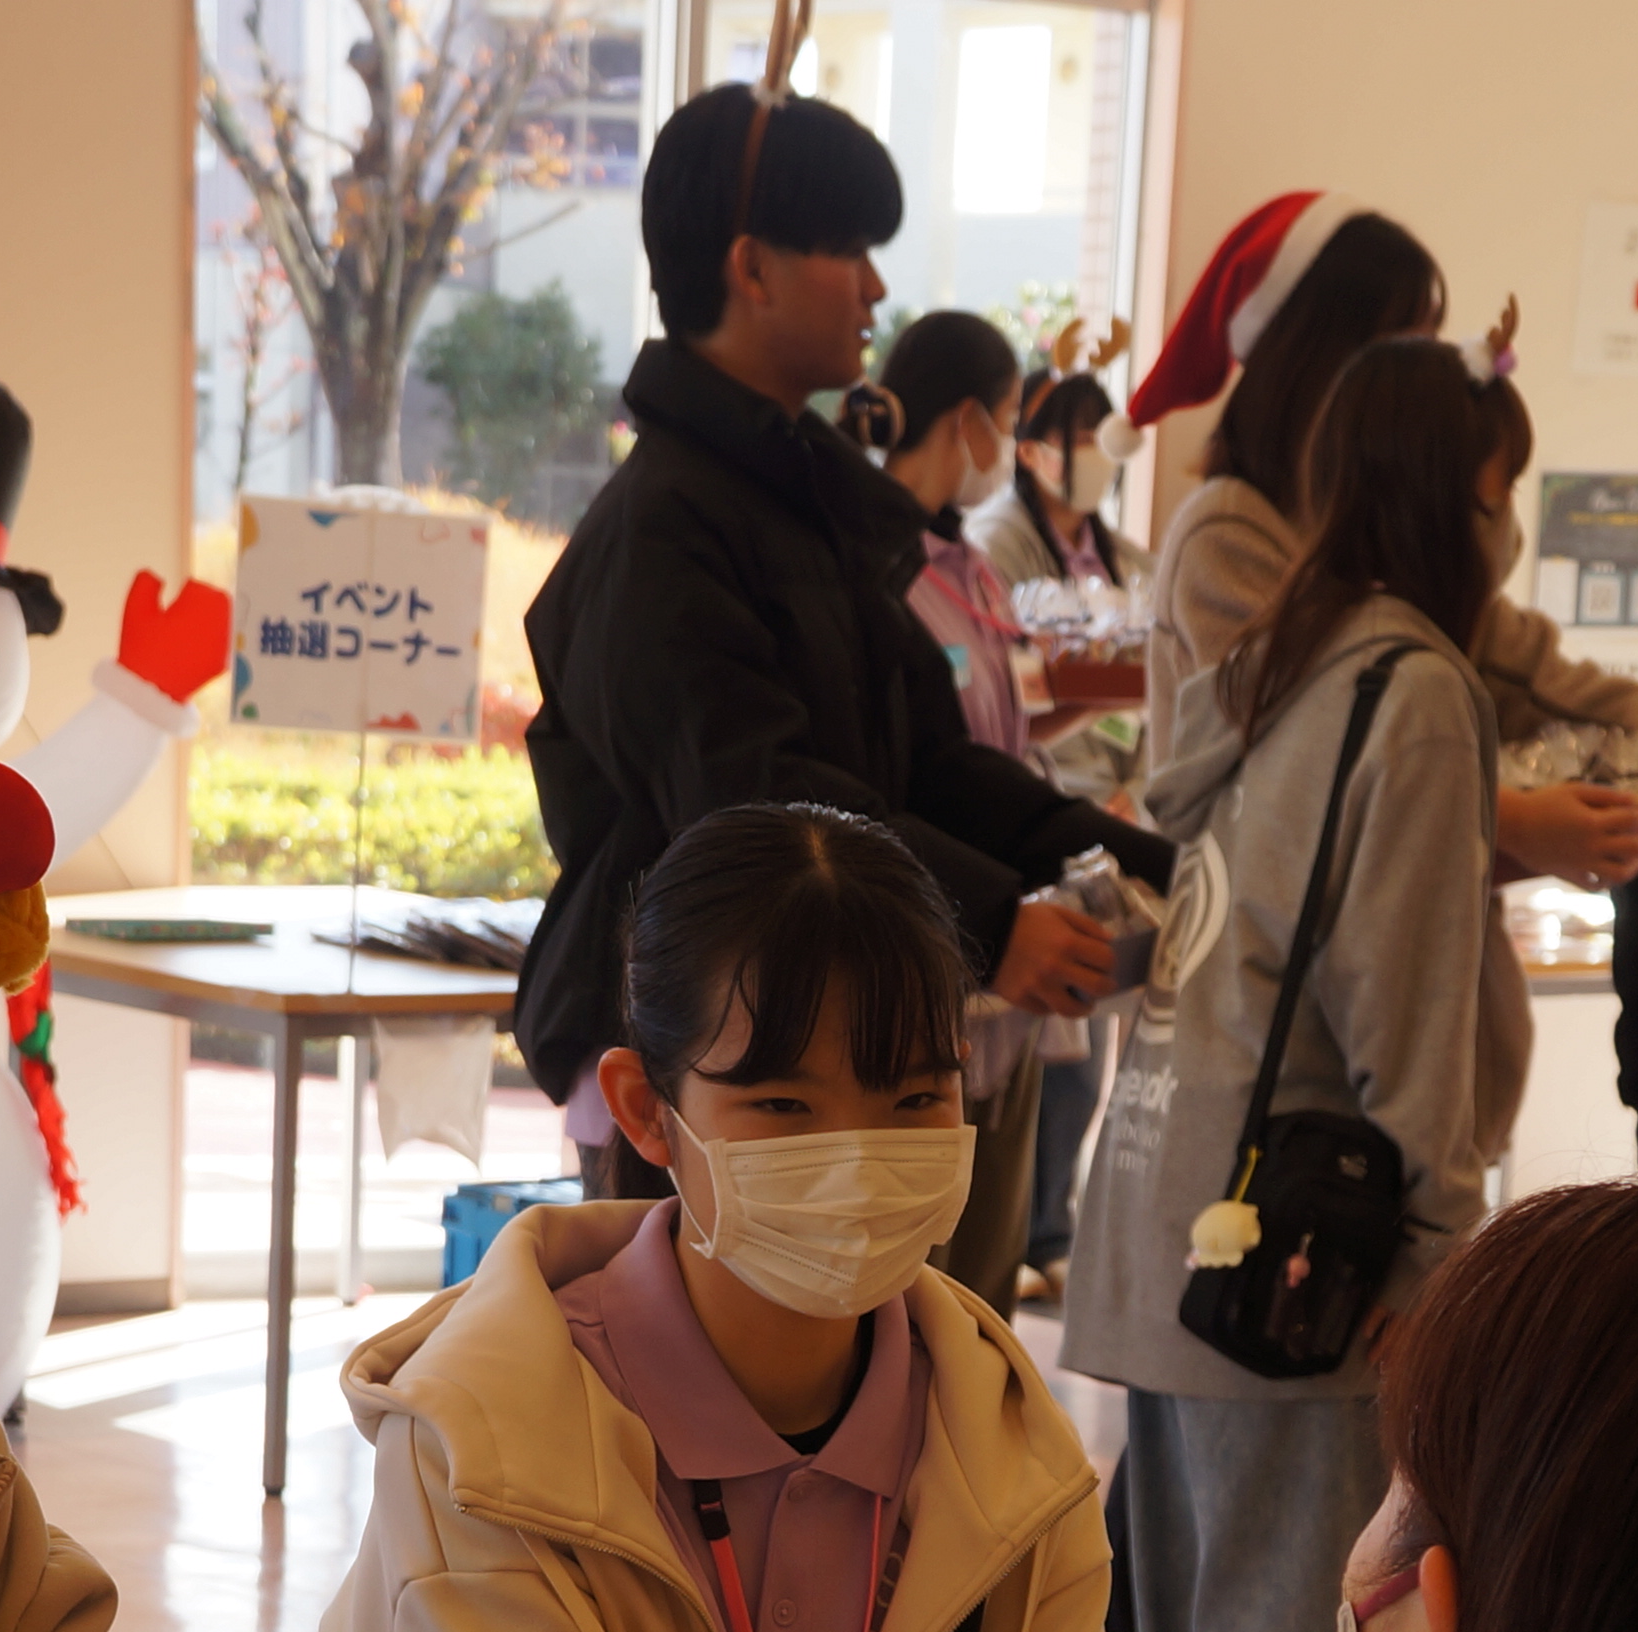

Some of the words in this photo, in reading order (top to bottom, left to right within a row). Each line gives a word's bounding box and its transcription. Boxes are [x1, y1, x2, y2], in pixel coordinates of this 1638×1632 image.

[300, 581, 433, 622] イベント
[259, 617, 461, 667] 抽選コーナー
